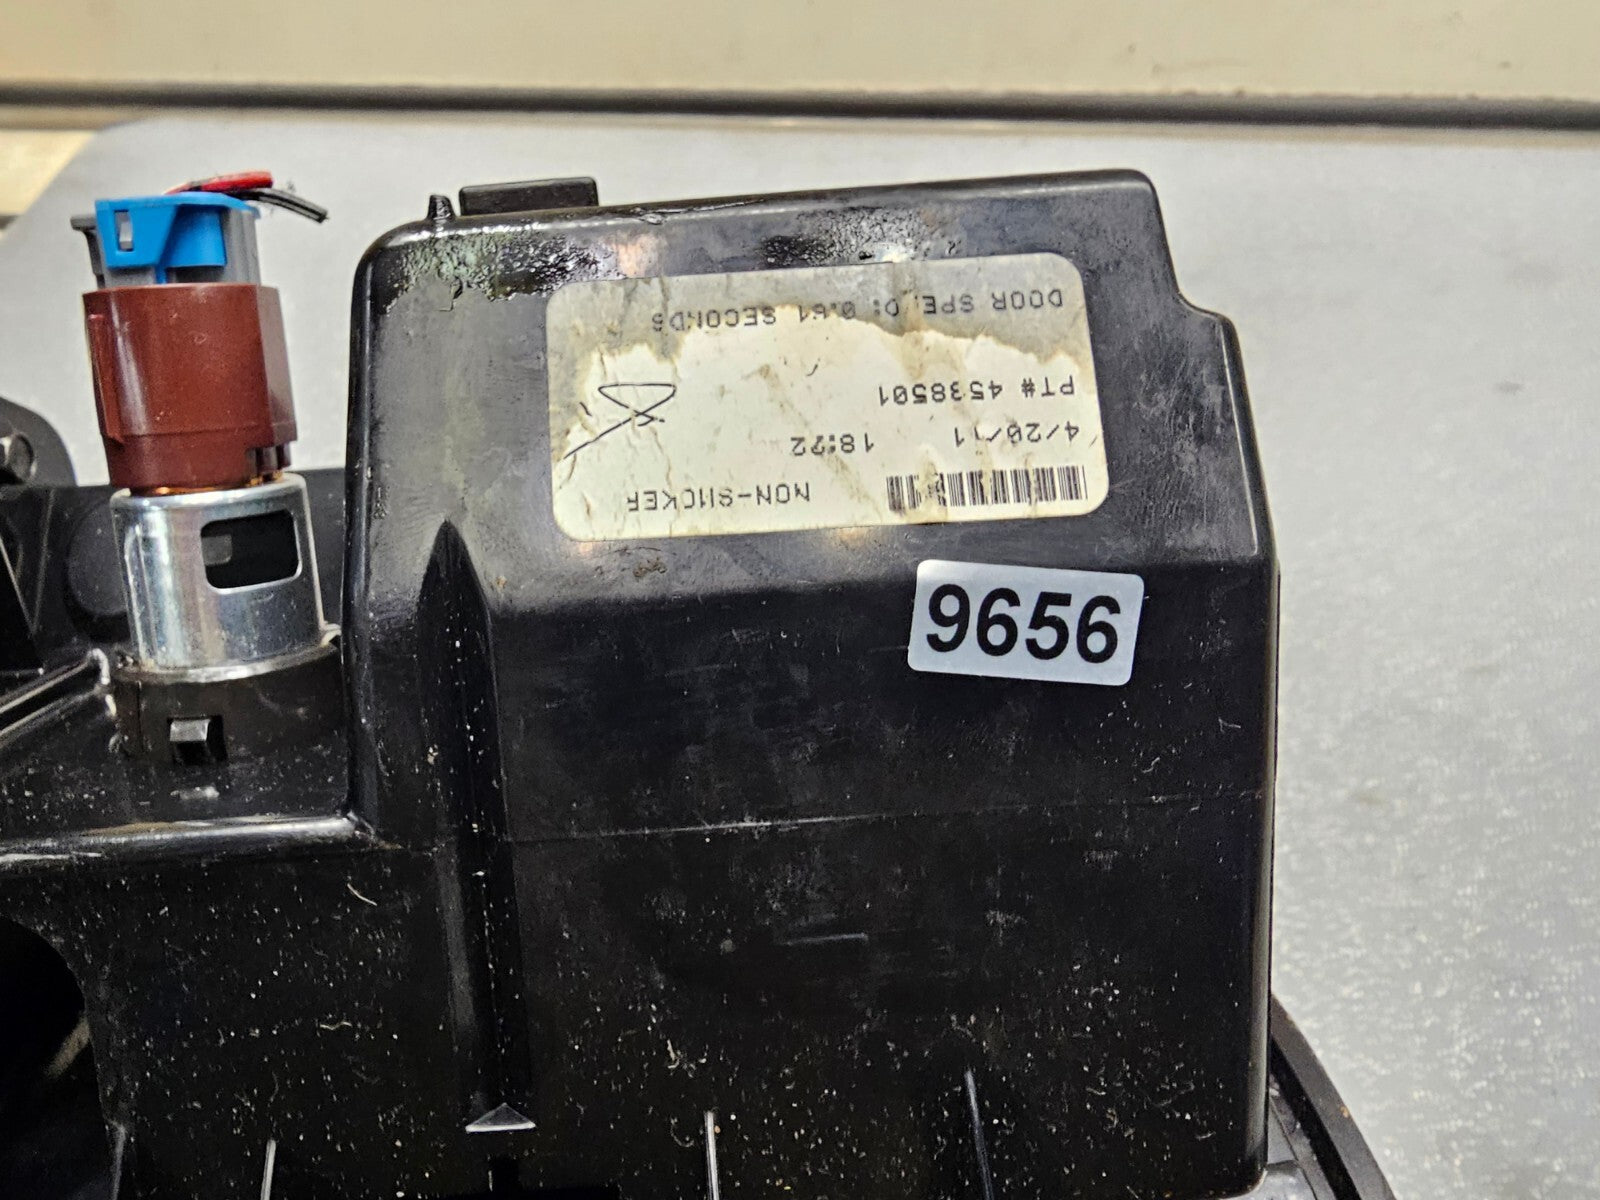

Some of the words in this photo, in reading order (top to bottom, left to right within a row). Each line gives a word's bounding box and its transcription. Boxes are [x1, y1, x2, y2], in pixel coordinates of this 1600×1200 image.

[873, 294, 974, 316] SPED:
[992, 289, 1063, 311] DOOR
[652, 305, 776, 332] SECONDS
[878, 381, 1003, 406] 4538501
[1021, 375, 1075, 398] PT#
[926, 583, 1121, 664] 9656
